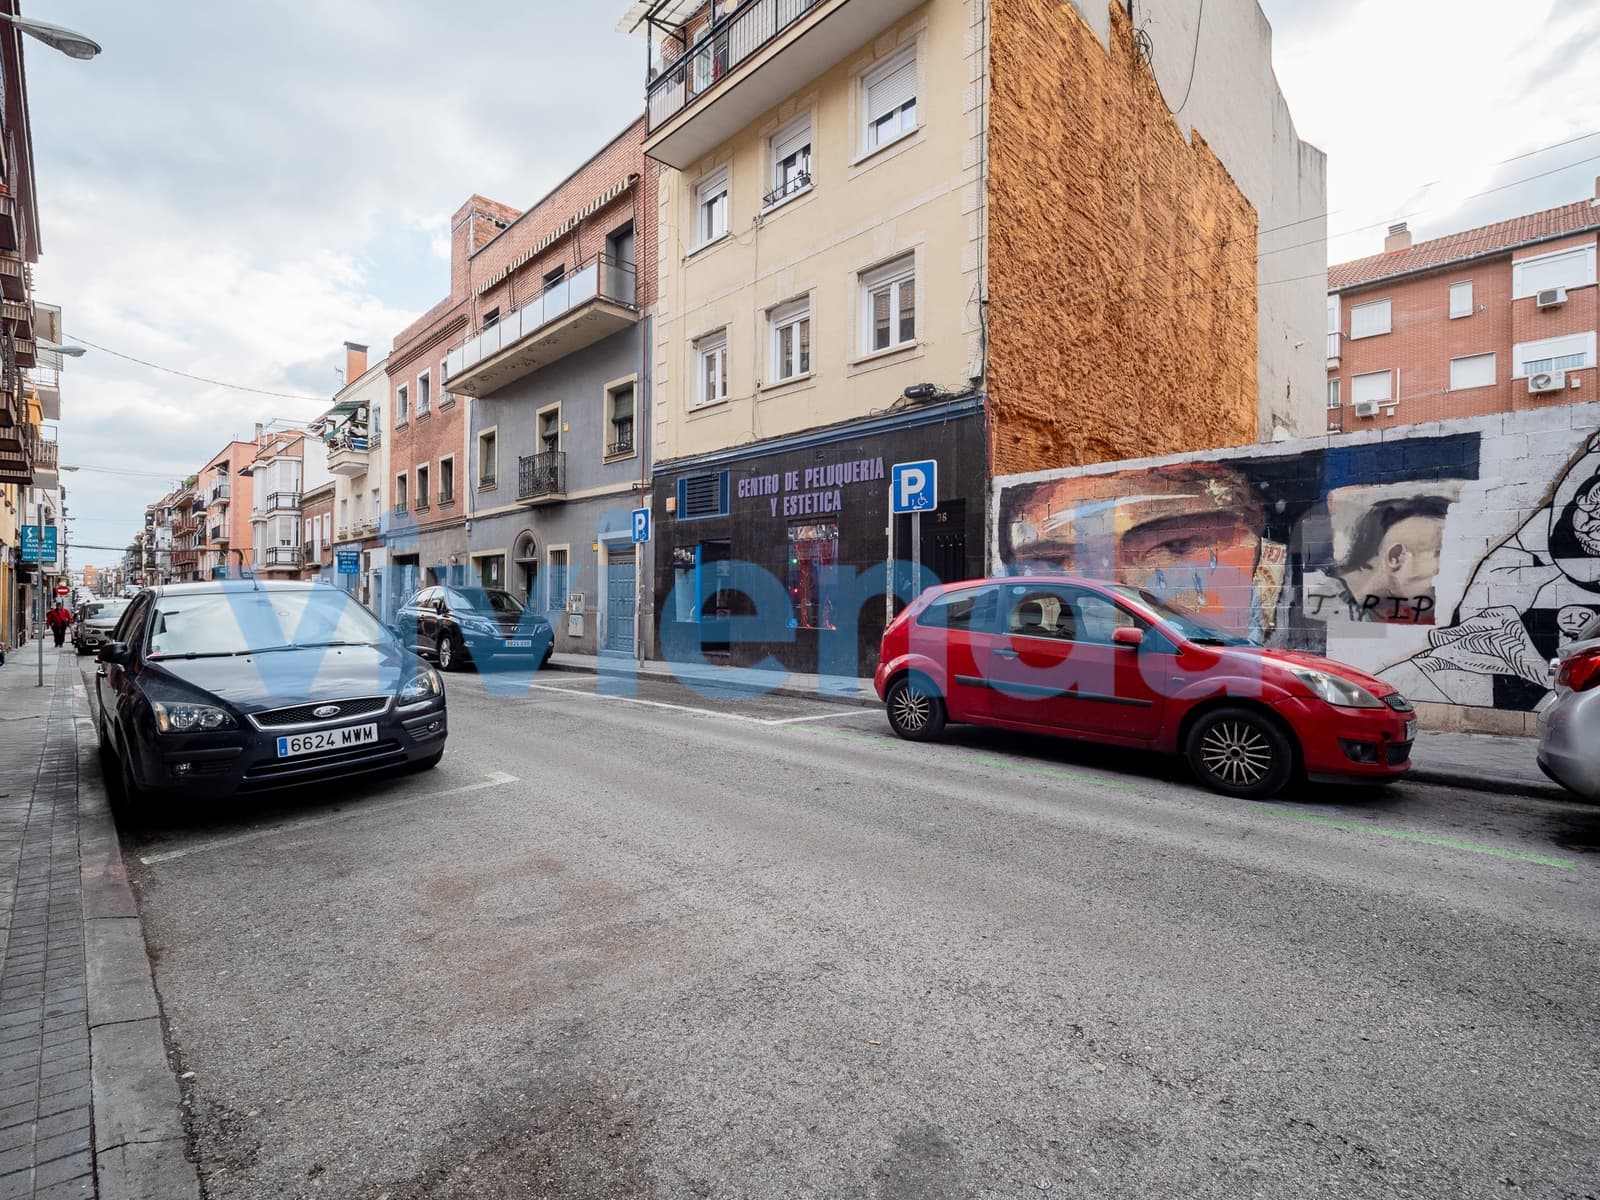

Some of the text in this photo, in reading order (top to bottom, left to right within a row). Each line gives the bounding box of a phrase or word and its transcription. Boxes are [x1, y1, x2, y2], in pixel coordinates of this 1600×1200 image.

[738, 457, 884, 498] CENTRO DE PELUQUERIA
[901, 468, 926, 507] P
[770, 490, 841, 517] Y ESTETICA
[635, 513, 646, 539] P
[1562, 612, 1591, 628] 19
[291, 726, 373, 752] 6624 MWM
